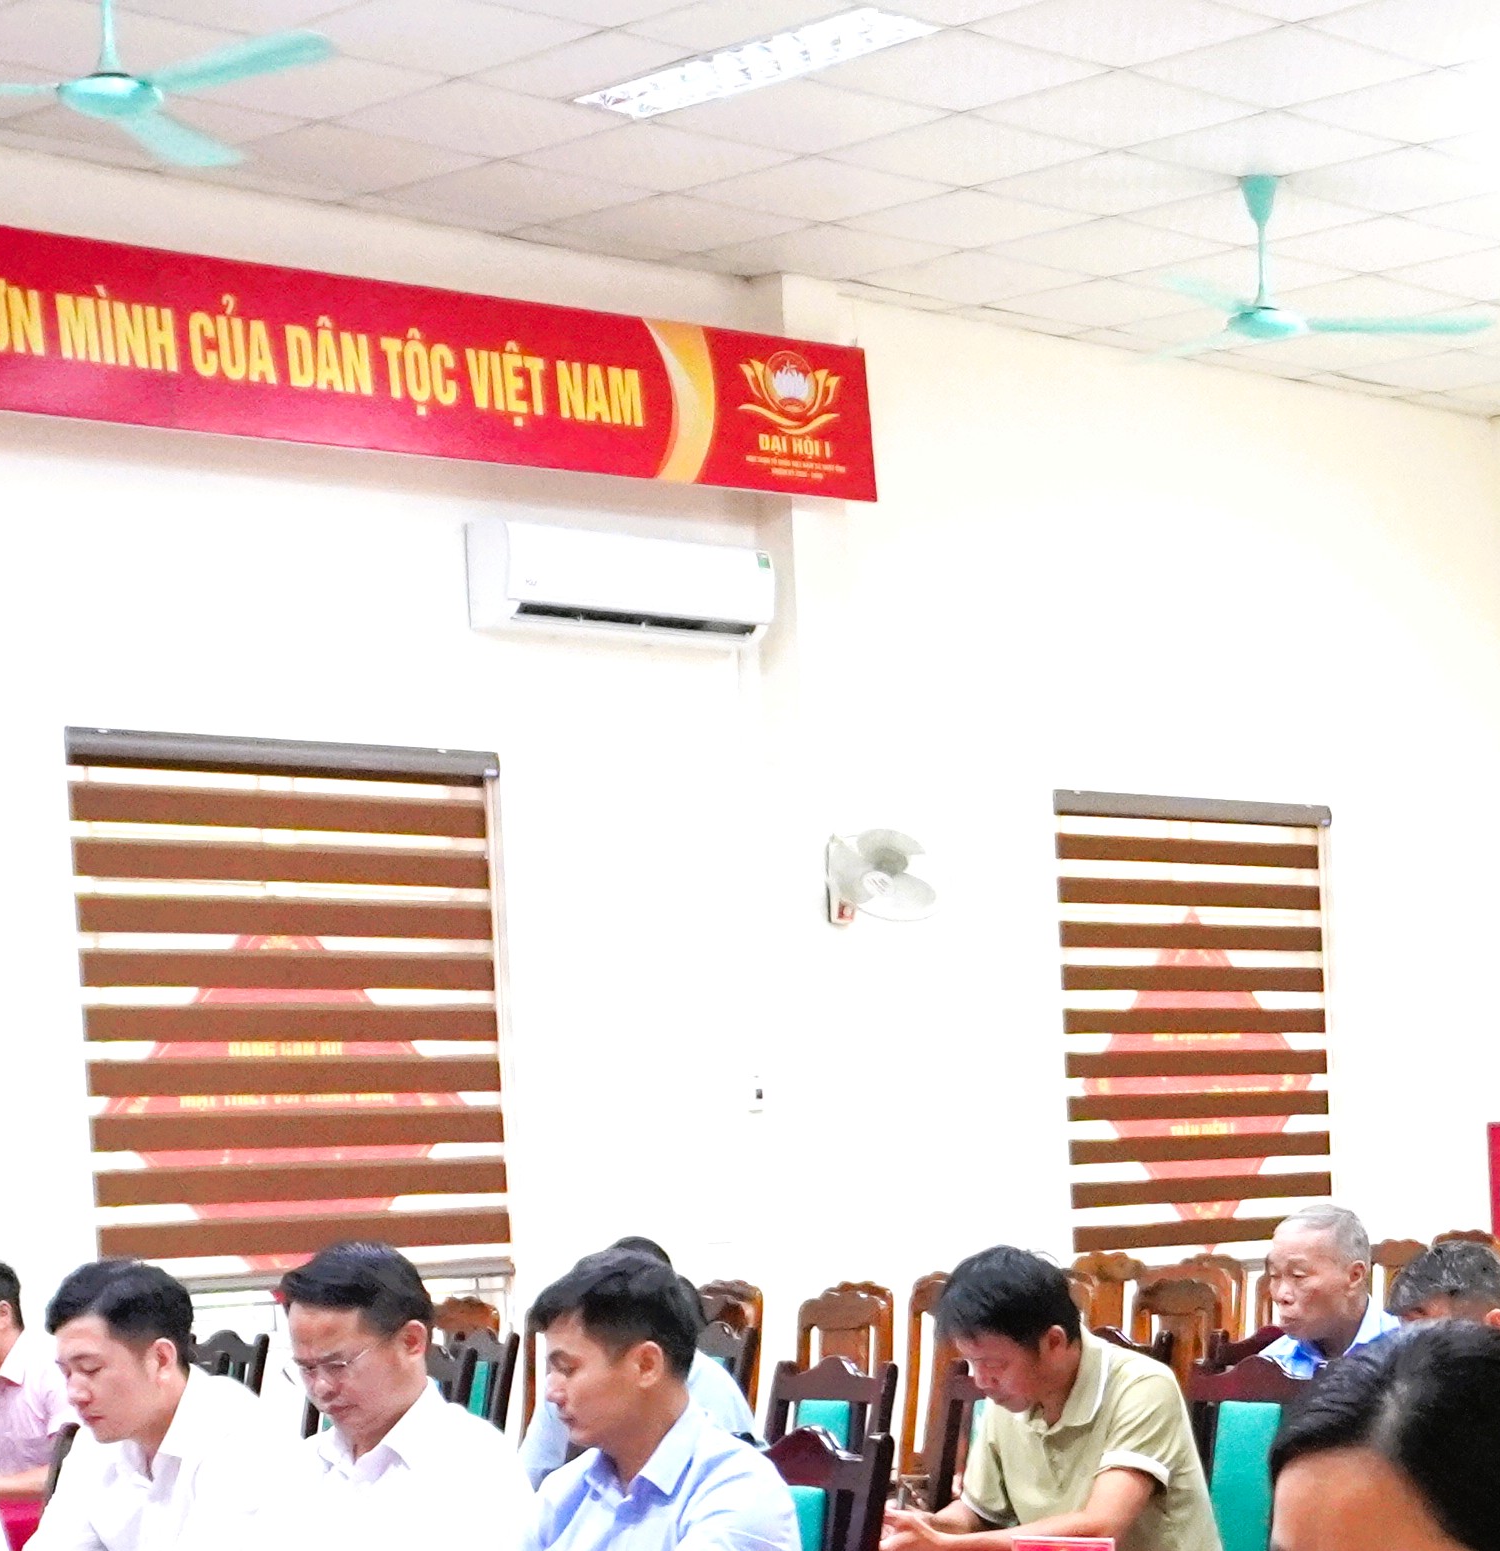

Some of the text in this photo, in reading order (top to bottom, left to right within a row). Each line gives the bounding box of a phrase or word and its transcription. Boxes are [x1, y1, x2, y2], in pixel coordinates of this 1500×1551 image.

[55, 283, 180, 372] MÌNH
[188, 295, 280, 386] CỦA
[284, 316, 376, 396] DÂN
[379, 327, 462, 418] TỘC
[464, 341, 547, 428] VIỆT
[555, 360, 646, 429] NAM
[758, 433, 788, 456] ĐẠI
[792, 435, 822, 460] HỘI
